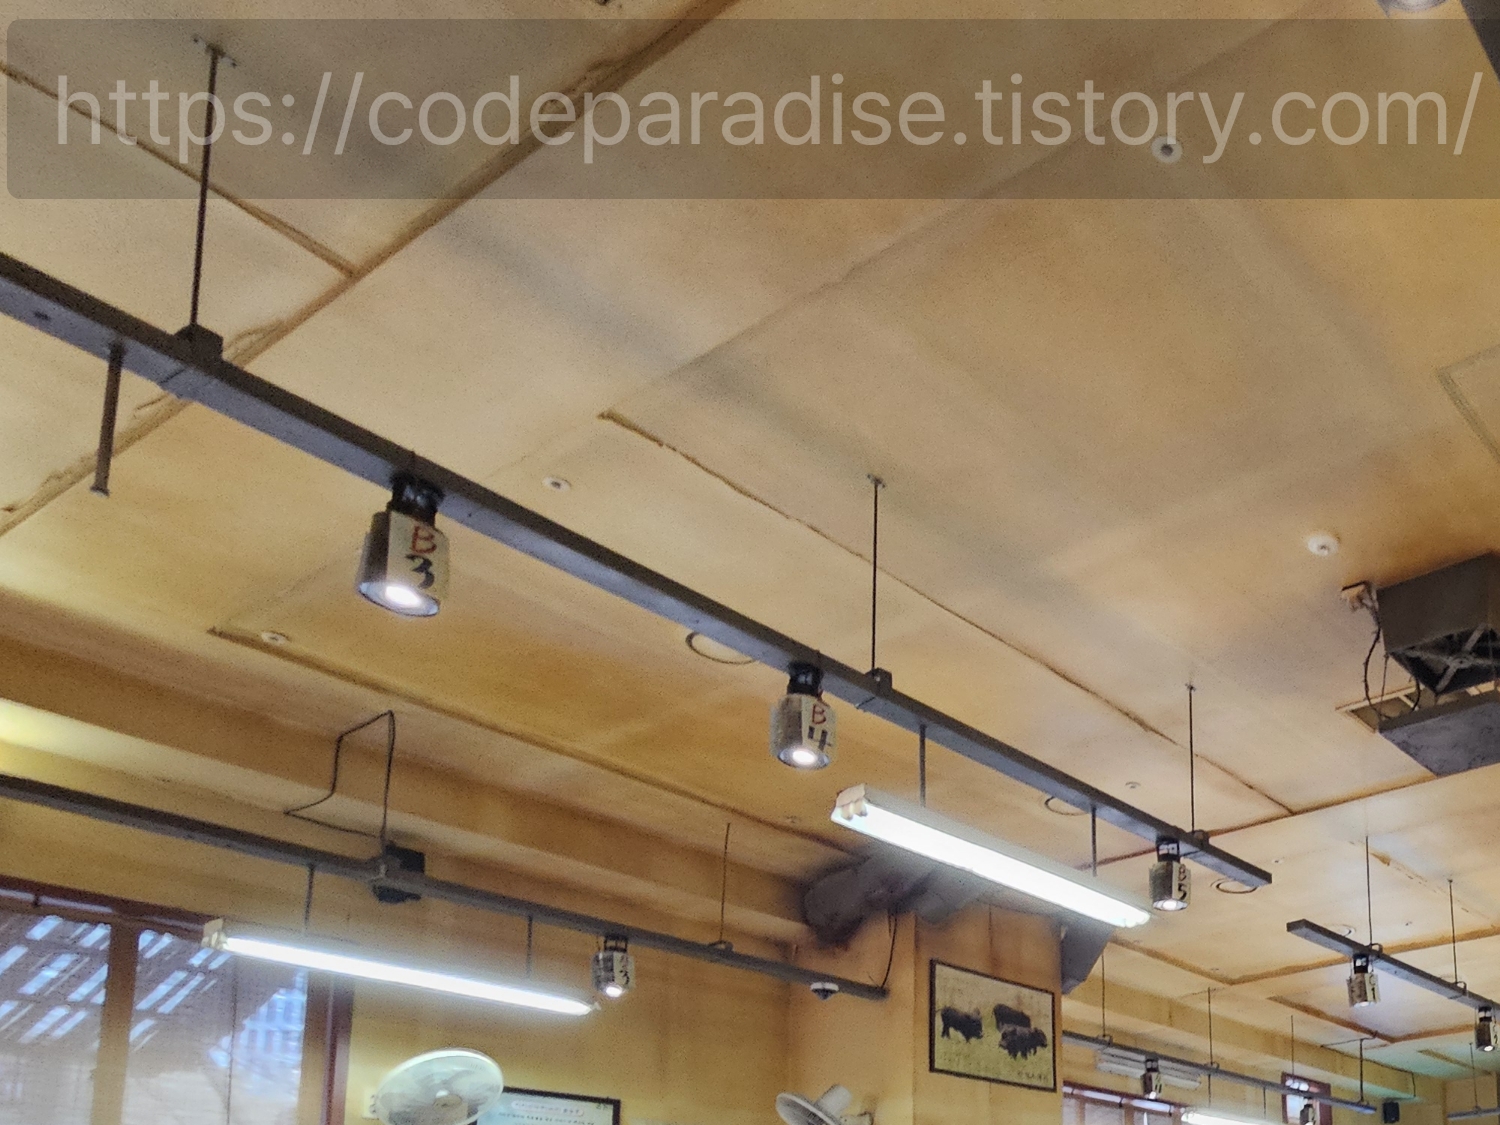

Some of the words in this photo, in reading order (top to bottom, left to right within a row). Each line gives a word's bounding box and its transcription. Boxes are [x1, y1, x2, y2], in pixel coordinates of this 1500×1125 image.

[411, 525, 437, 555] B
[405, 554, 435, 589] 3
[810, 703, 828, 725] B
[807, 726, 833, 749] 4
